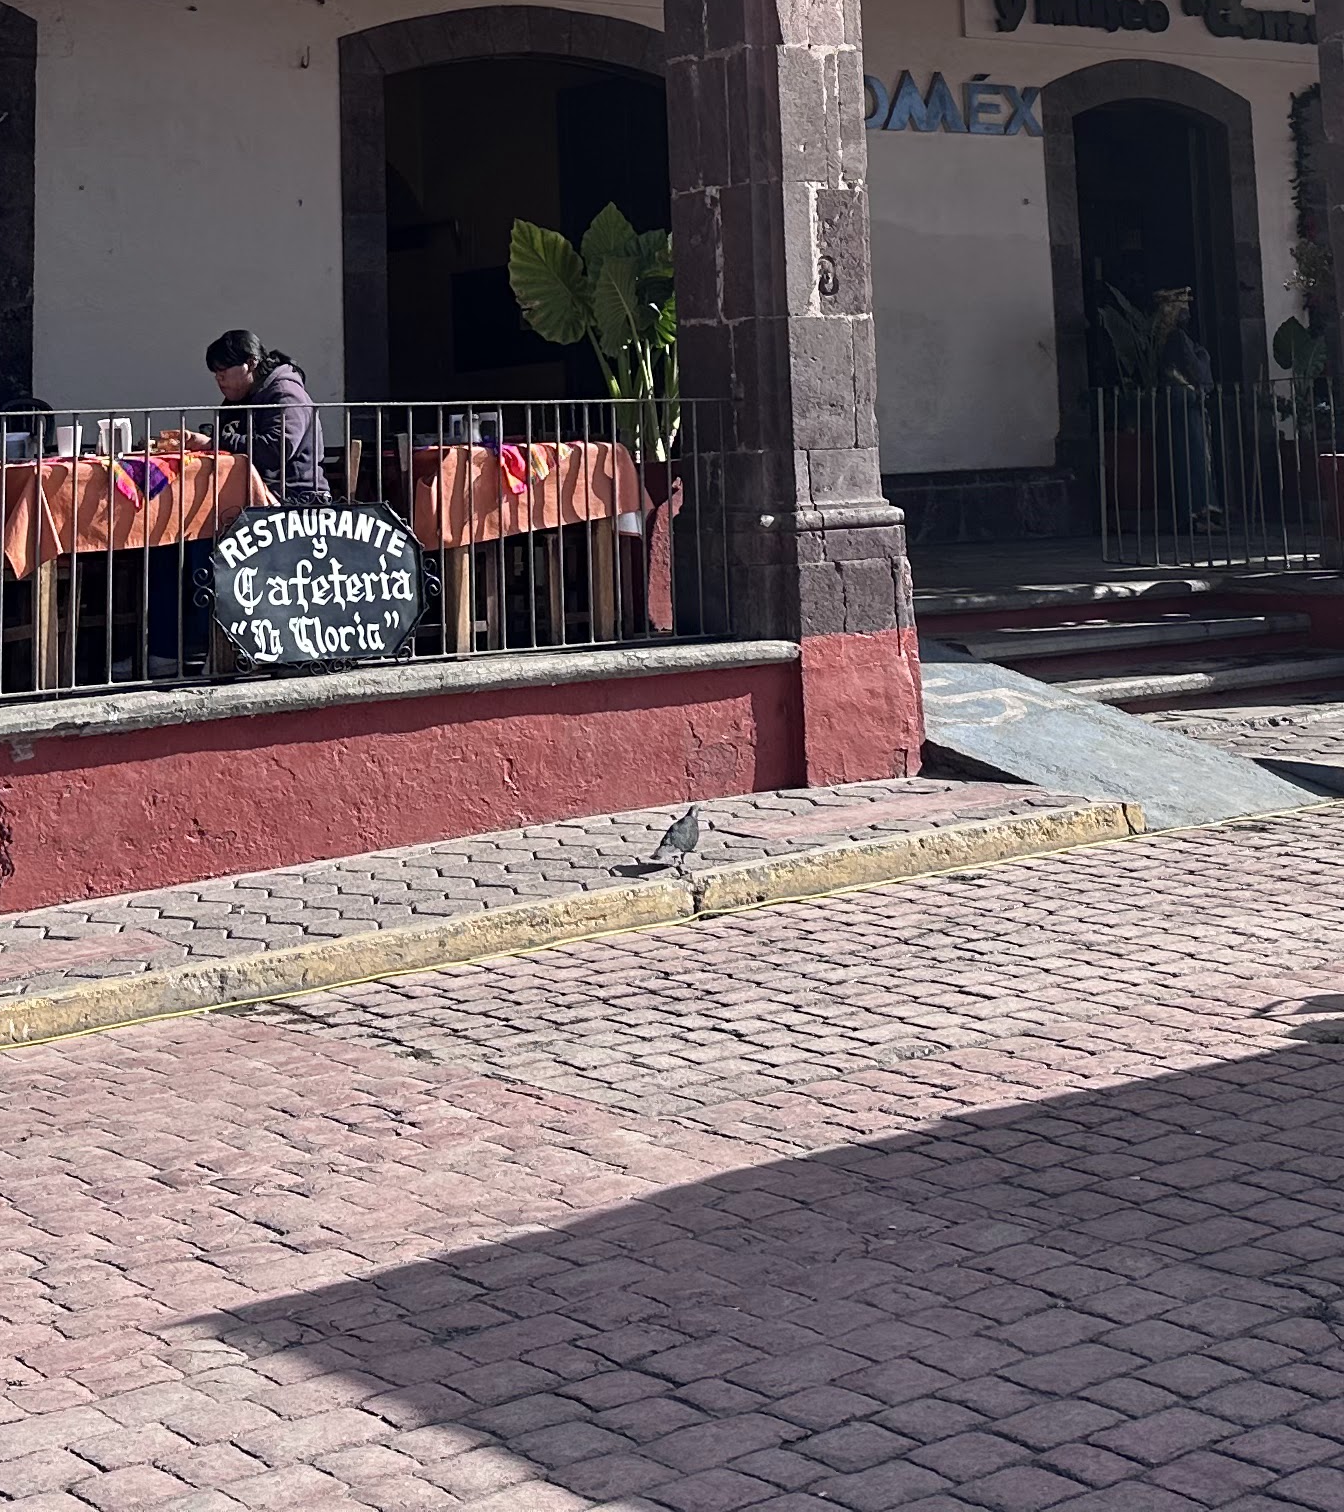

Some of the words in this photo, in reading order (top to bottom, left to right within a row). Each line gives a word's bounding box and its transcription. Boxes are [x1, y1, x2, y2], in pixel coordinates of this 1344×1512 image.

[218, 508, 407, 568] RESTAURANTE
[312, 536, 328, 559] y
[233, 554, 414, 614] Cafetería
